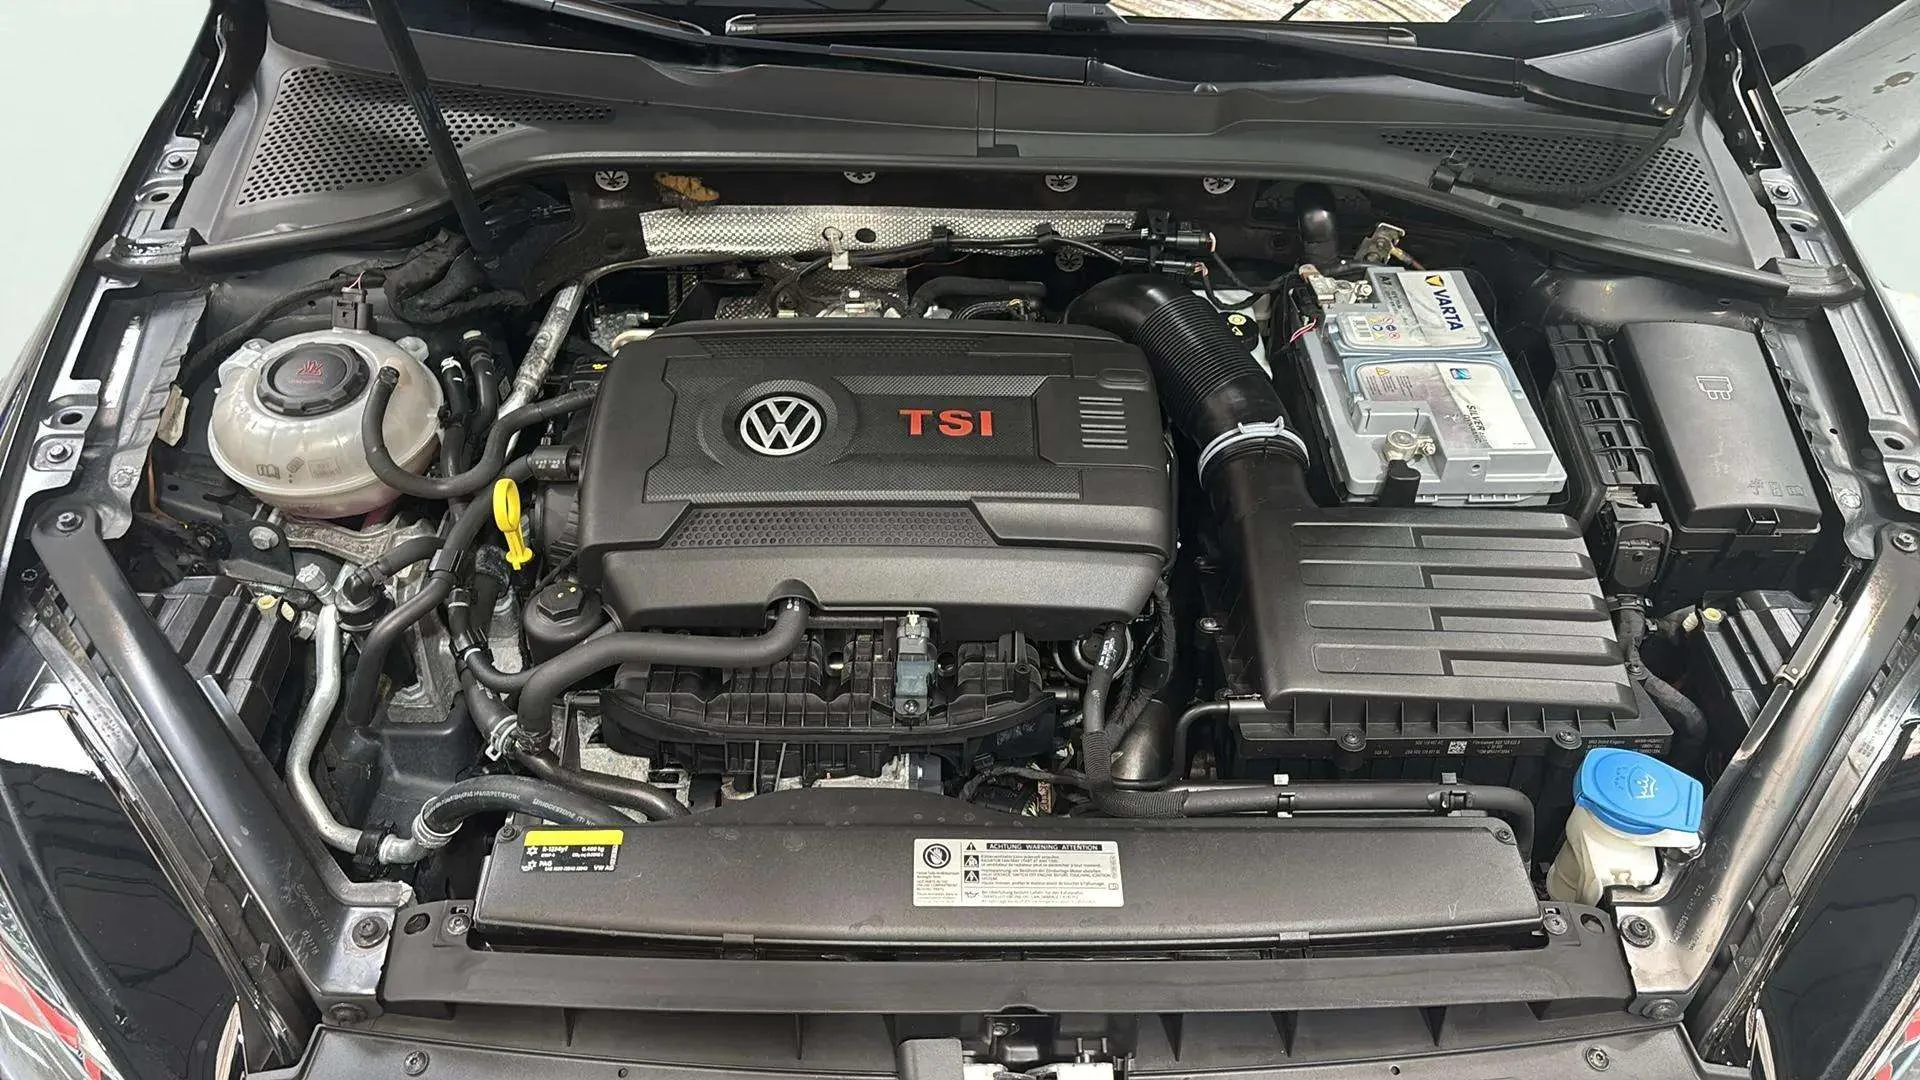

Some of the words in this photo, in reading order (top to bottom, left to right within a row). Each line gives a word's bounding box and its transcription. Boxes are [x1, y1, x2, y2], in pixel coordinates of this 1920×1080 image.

[1433, 289, 1464, 331] VARTA
[899, 409, 993, 437] TSI
[1466, 404, 1486, 431] SILVER
[1061, 844, 1098, 852] ATTENTION
